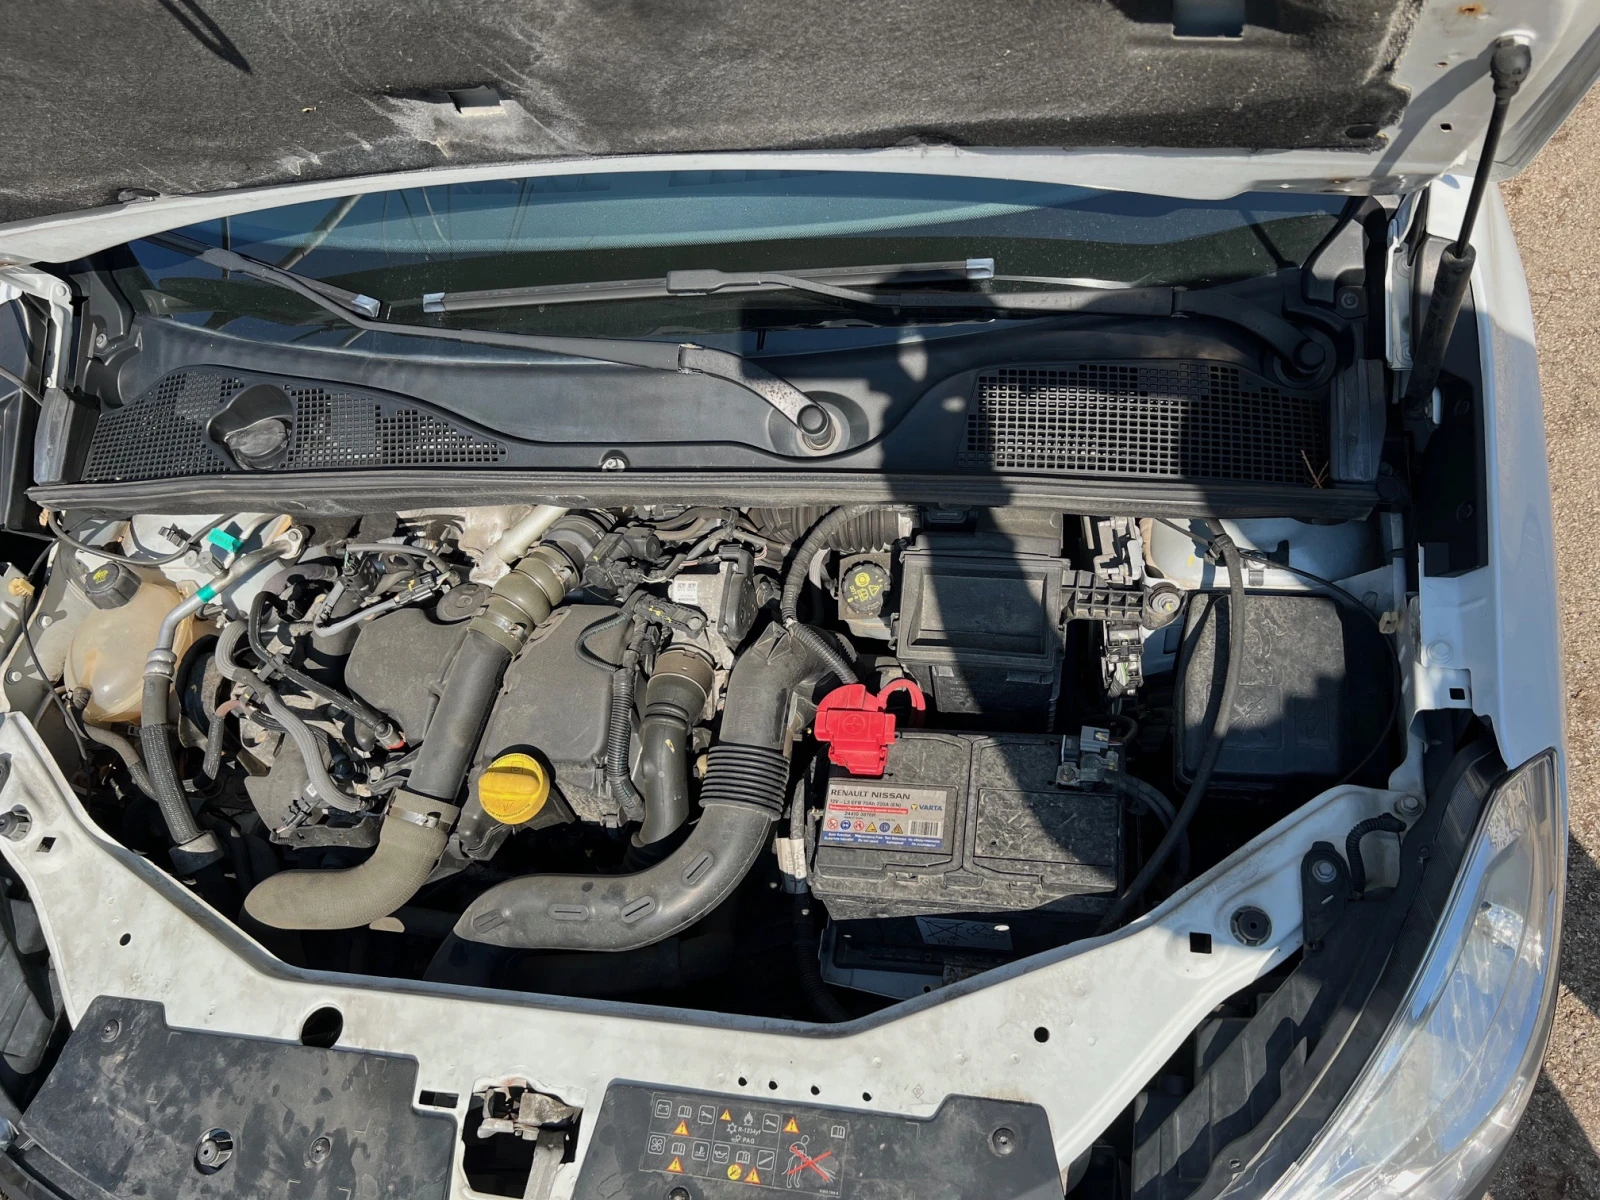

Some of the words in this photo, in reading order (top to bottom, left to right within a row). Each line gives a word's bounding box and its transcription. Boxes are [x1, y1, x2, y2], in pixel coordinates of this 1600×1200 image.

[830, 789, 869, 797] RENAULT
[871, 792, 910, 800] NISSAN
[738, 1126, 761, 1136] R-1234yf
